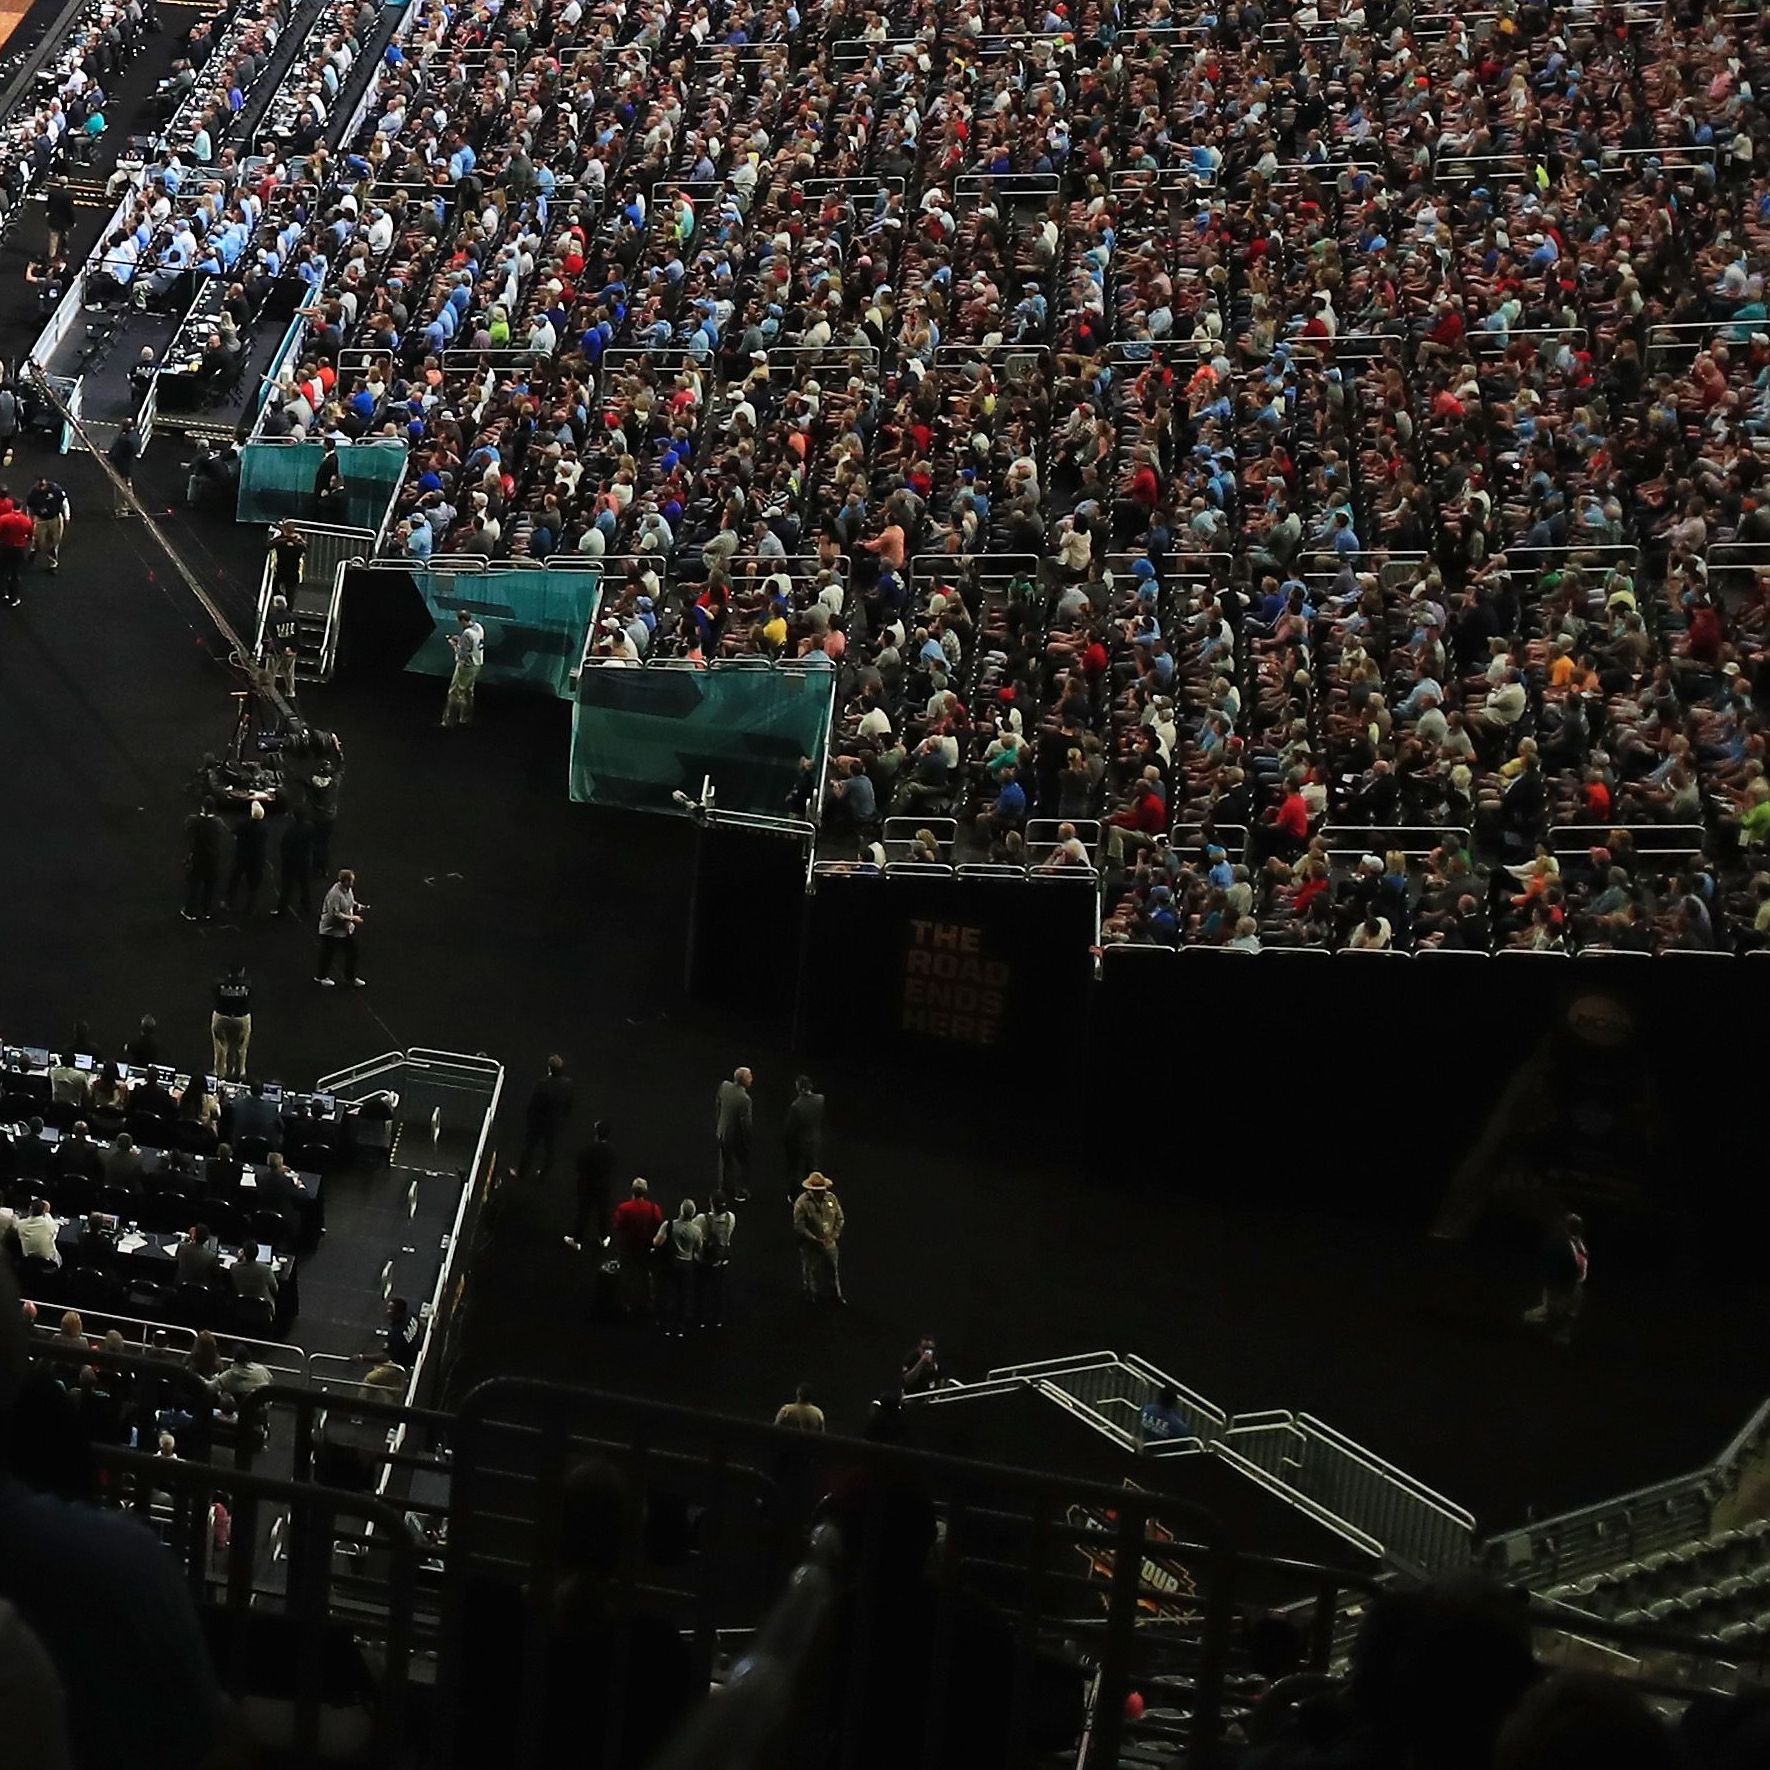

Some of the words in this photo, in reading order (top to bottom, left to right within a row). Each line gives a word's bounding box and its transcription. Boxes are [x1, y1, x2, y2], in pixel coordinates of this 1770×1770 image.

[910, 919, 981, 953] THE
[907, 949, 1009, 987] ROAD
[905, 977, 1003, 1015] ENDS
